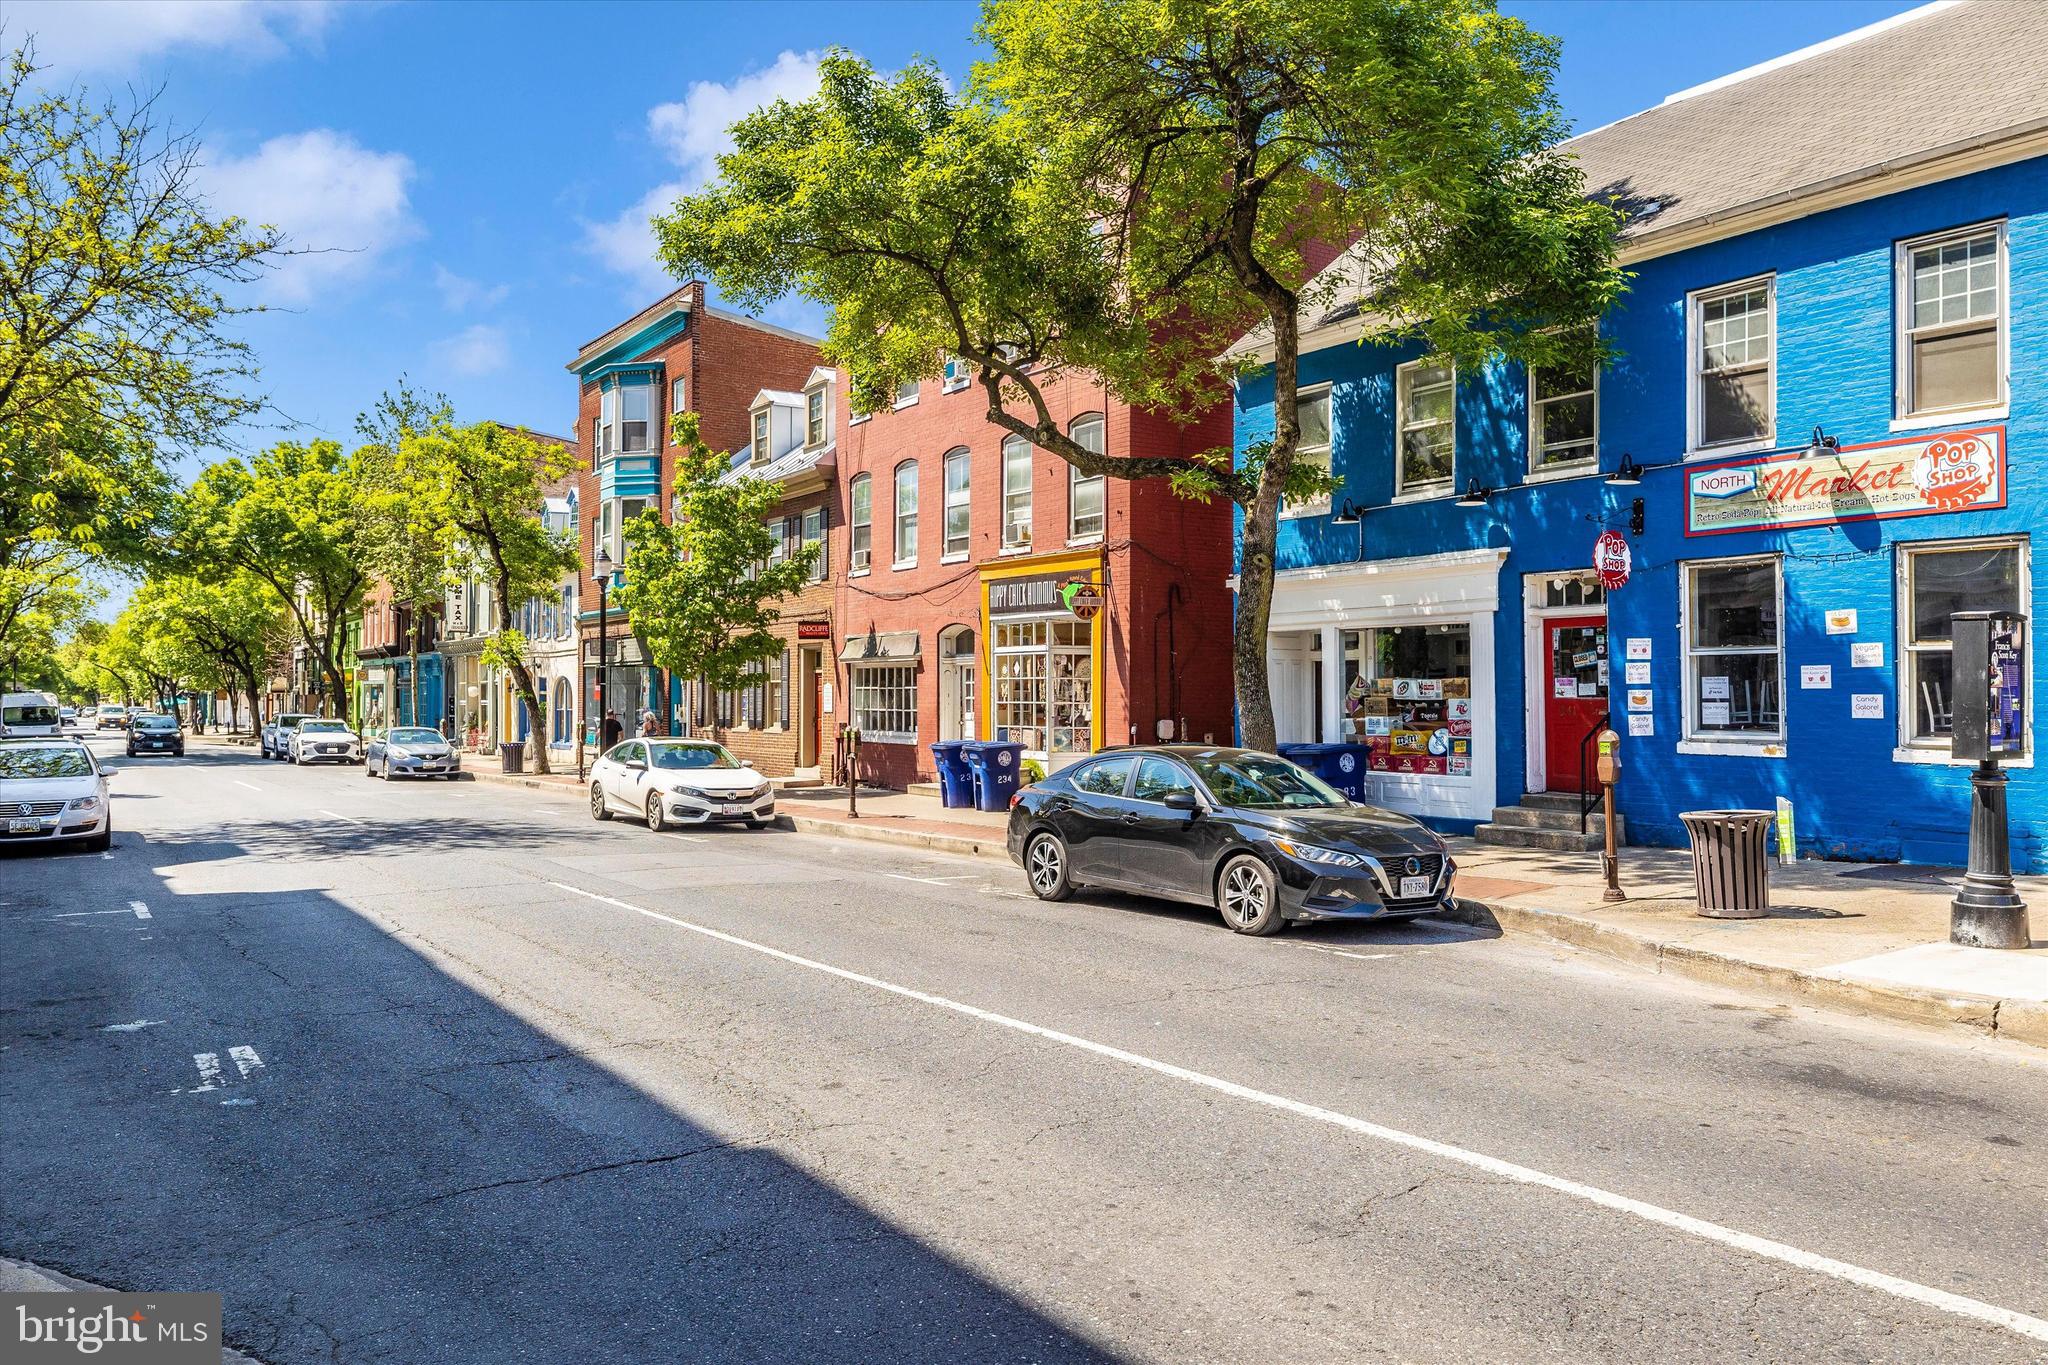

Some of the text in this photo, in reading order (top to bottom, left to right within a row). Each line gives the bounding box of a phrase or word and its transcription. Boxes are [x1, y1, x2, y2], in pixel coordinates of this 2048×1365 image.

[1929, 441, 1976, 468] POP
[1763, 459, 1904, 502] Market
[1930, 465, 1977, 486] SHOP
[1701, 475, 1746, 490] NORTH
[1697, 512, 1720, 521] Retro
[1722, 509, 1741, 520] Soda
[1834, 498, 1866, 508] Cream
[1871, 494, 1889, 504] Hot
[1892, 491, 1916, 502] Dogs
[1603, 535, 1626, 556] POP
[1603, 557, 1626, 569] SHOP
[1008, 583, 1027, 607] CHICK
[1027, 580, 1057, 606] HUMMUS
[1854, 644, 1880, 654] Vegan
[2009, 651, 2018, 661] Key
[1628, 664, 1648, 672] Vegan
[1855, 696, 1879, 704] Candy
[1455, 704, 1469, 715] RC
[1855, 703, 1880, 711] Galore!
[960, 773, 972, 782] 23
[997, 775, 1012, 784] 234
